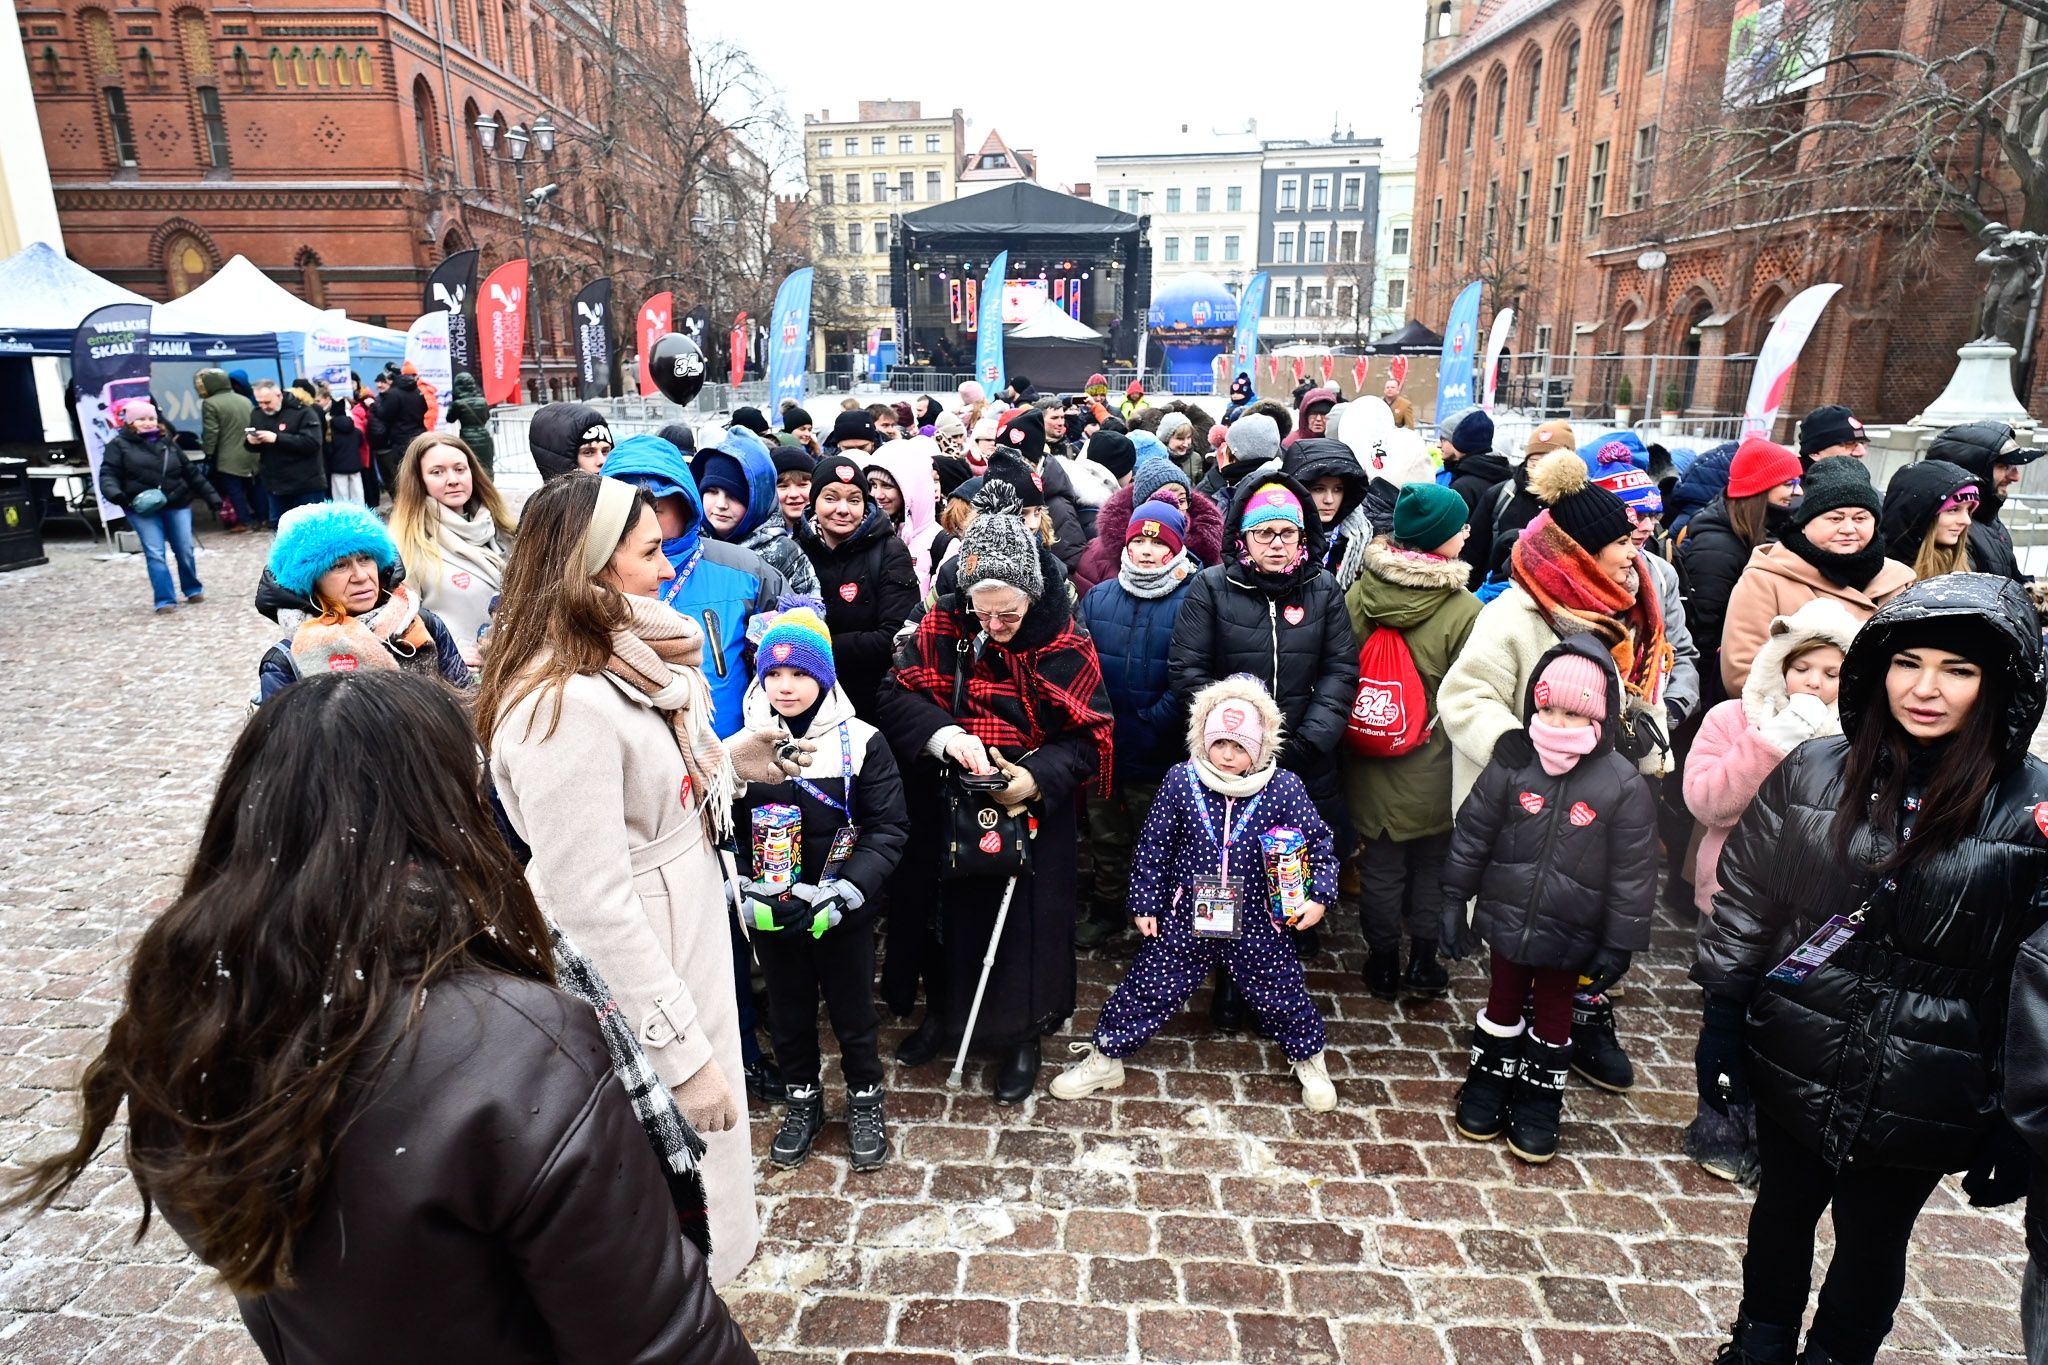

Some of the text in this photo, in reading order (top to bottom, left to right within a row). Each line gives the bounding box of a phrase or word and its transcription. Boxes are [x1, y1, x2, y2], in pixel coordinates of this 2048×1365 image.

[93, 318, 148, 334] WIELKIE
[87, 332, 135, 347] emocje
[90, 342, 135, 360] SKALI
[1355, 693, 1389, 718] 34
[1360, 728, 1386, 737] mBank
[982, 812, 994, 825] M
